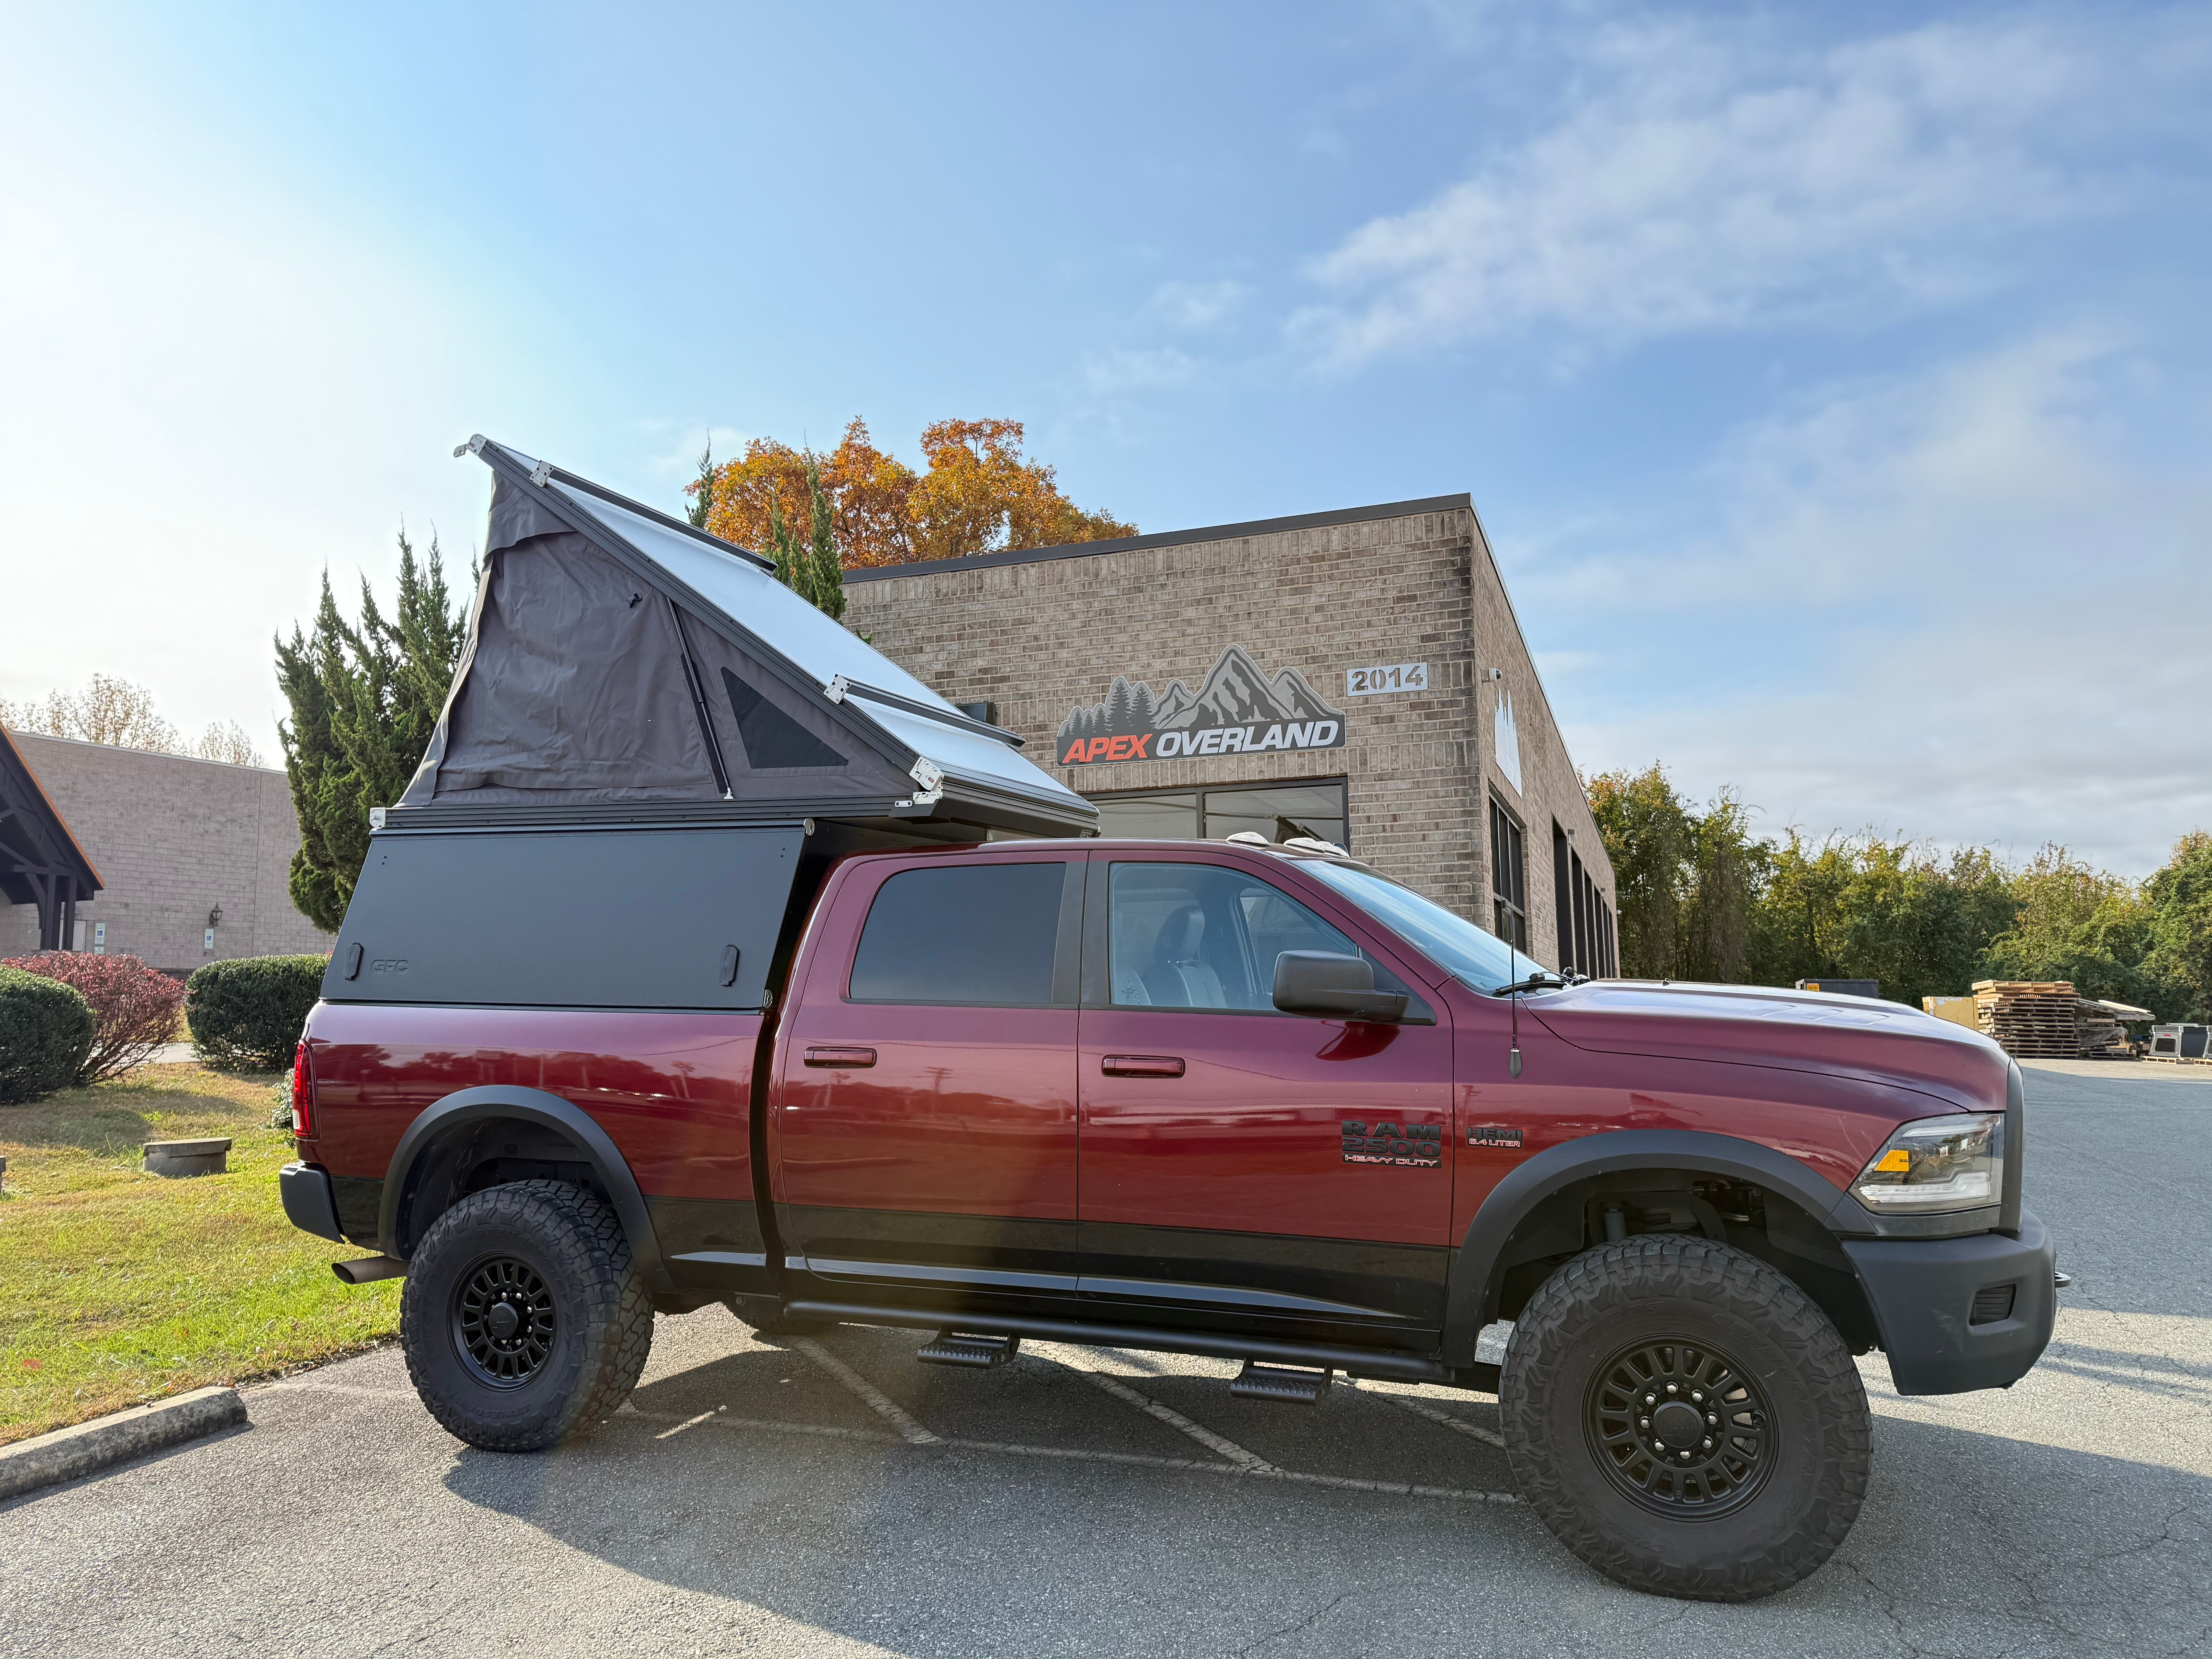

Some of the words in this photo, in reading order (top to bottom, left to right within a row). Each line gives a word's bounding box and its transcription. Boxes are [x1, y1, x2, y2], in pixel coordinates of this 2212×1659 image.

[1352, 666, 1423, 692] 2014
[1062, 734, 1152, 763] APEX
[1156, 720, 1339, 757] OVERLAND
[371, 960, 409, 974] GFC
[1342, 1120, 1441, 1140] RAM
[1467, 1127, 1523, 1139] HEMI
[1342, 1137, 1441, 1157] 2500
[1345, 1155, 1393, 1164] HEAVY
